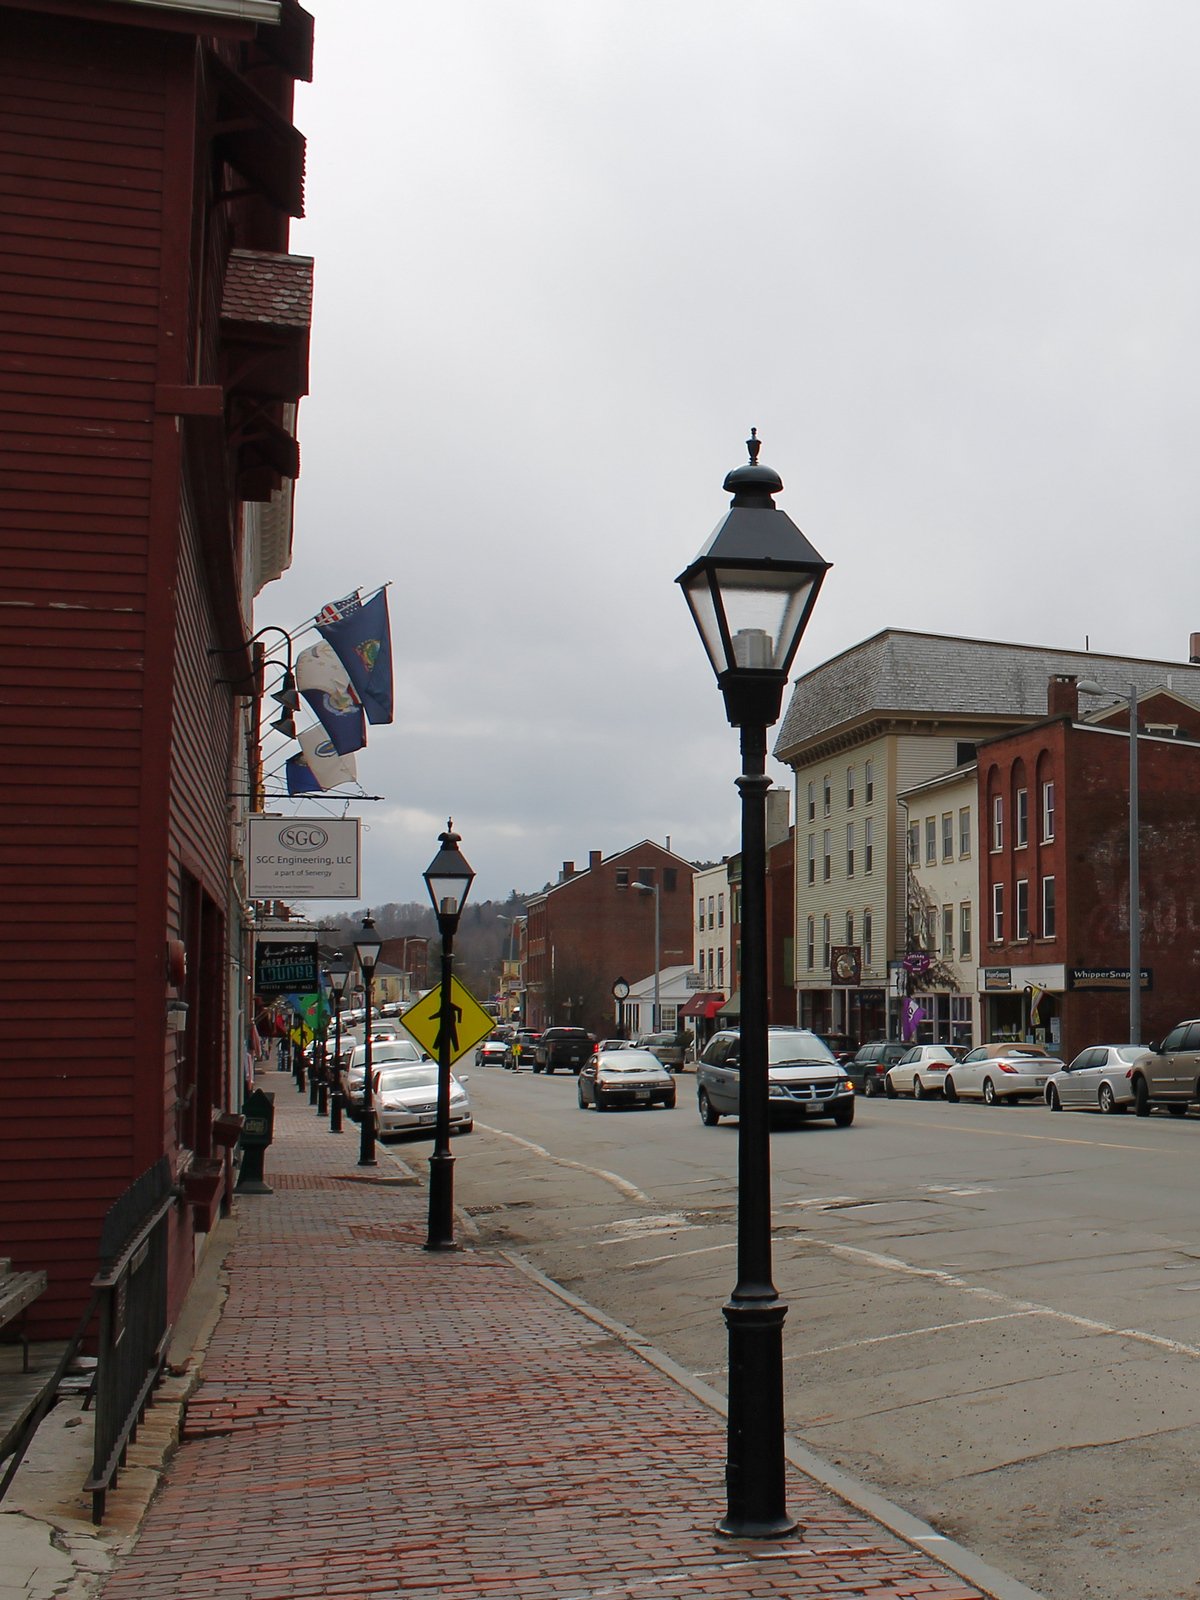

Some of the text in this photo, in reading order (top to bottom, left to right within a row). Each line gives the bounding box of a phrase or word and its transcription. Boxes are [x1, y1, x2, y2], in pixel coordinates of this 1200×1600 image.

[286, 831, 320, 846] SGC
[256, 856, 352, 865] SGC Engineering, LLC
[1074, 970, 1148, 979] WhipperSnaprs
